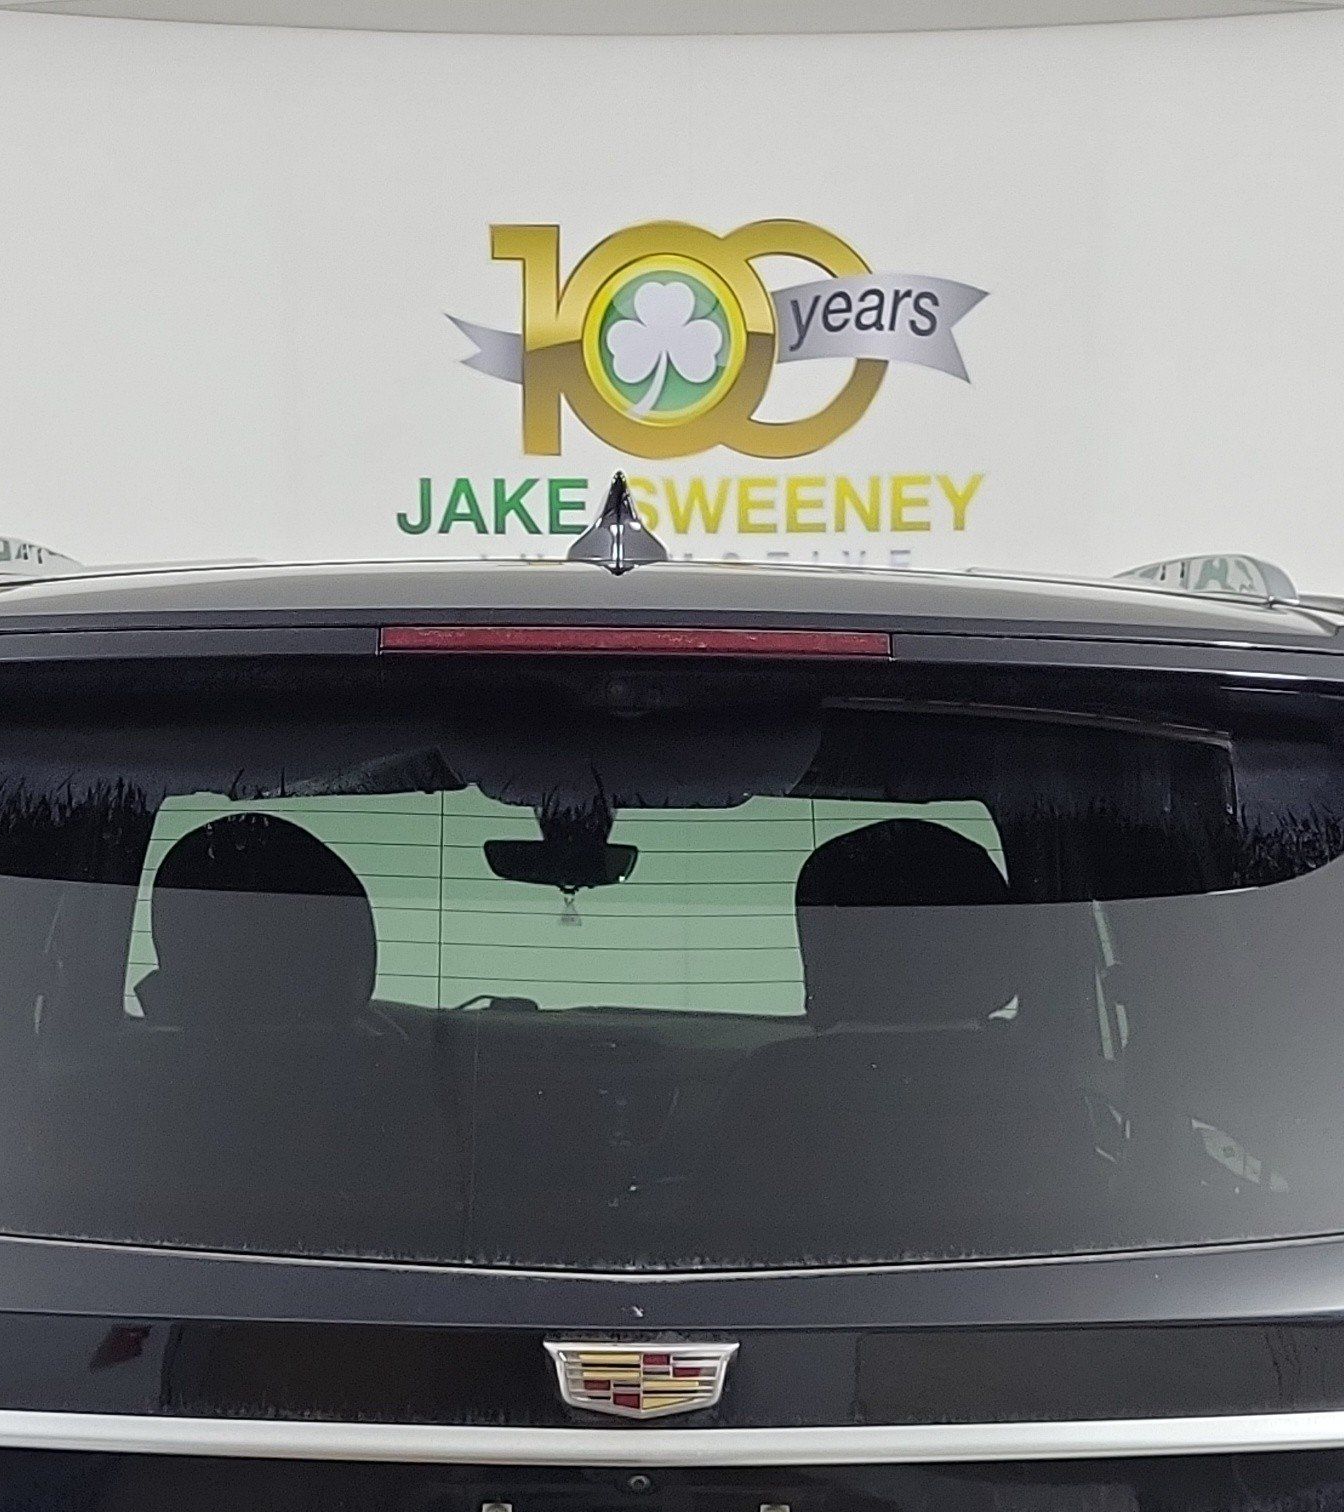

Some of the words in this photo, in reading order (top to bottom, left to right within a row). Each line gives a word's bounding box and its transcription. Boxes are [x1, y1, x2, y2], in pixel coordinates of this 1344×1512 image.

[489, 218, 889, 459] 100
[788, 284, 941, 352] years
[397, 477, 589, 535] JAKE
